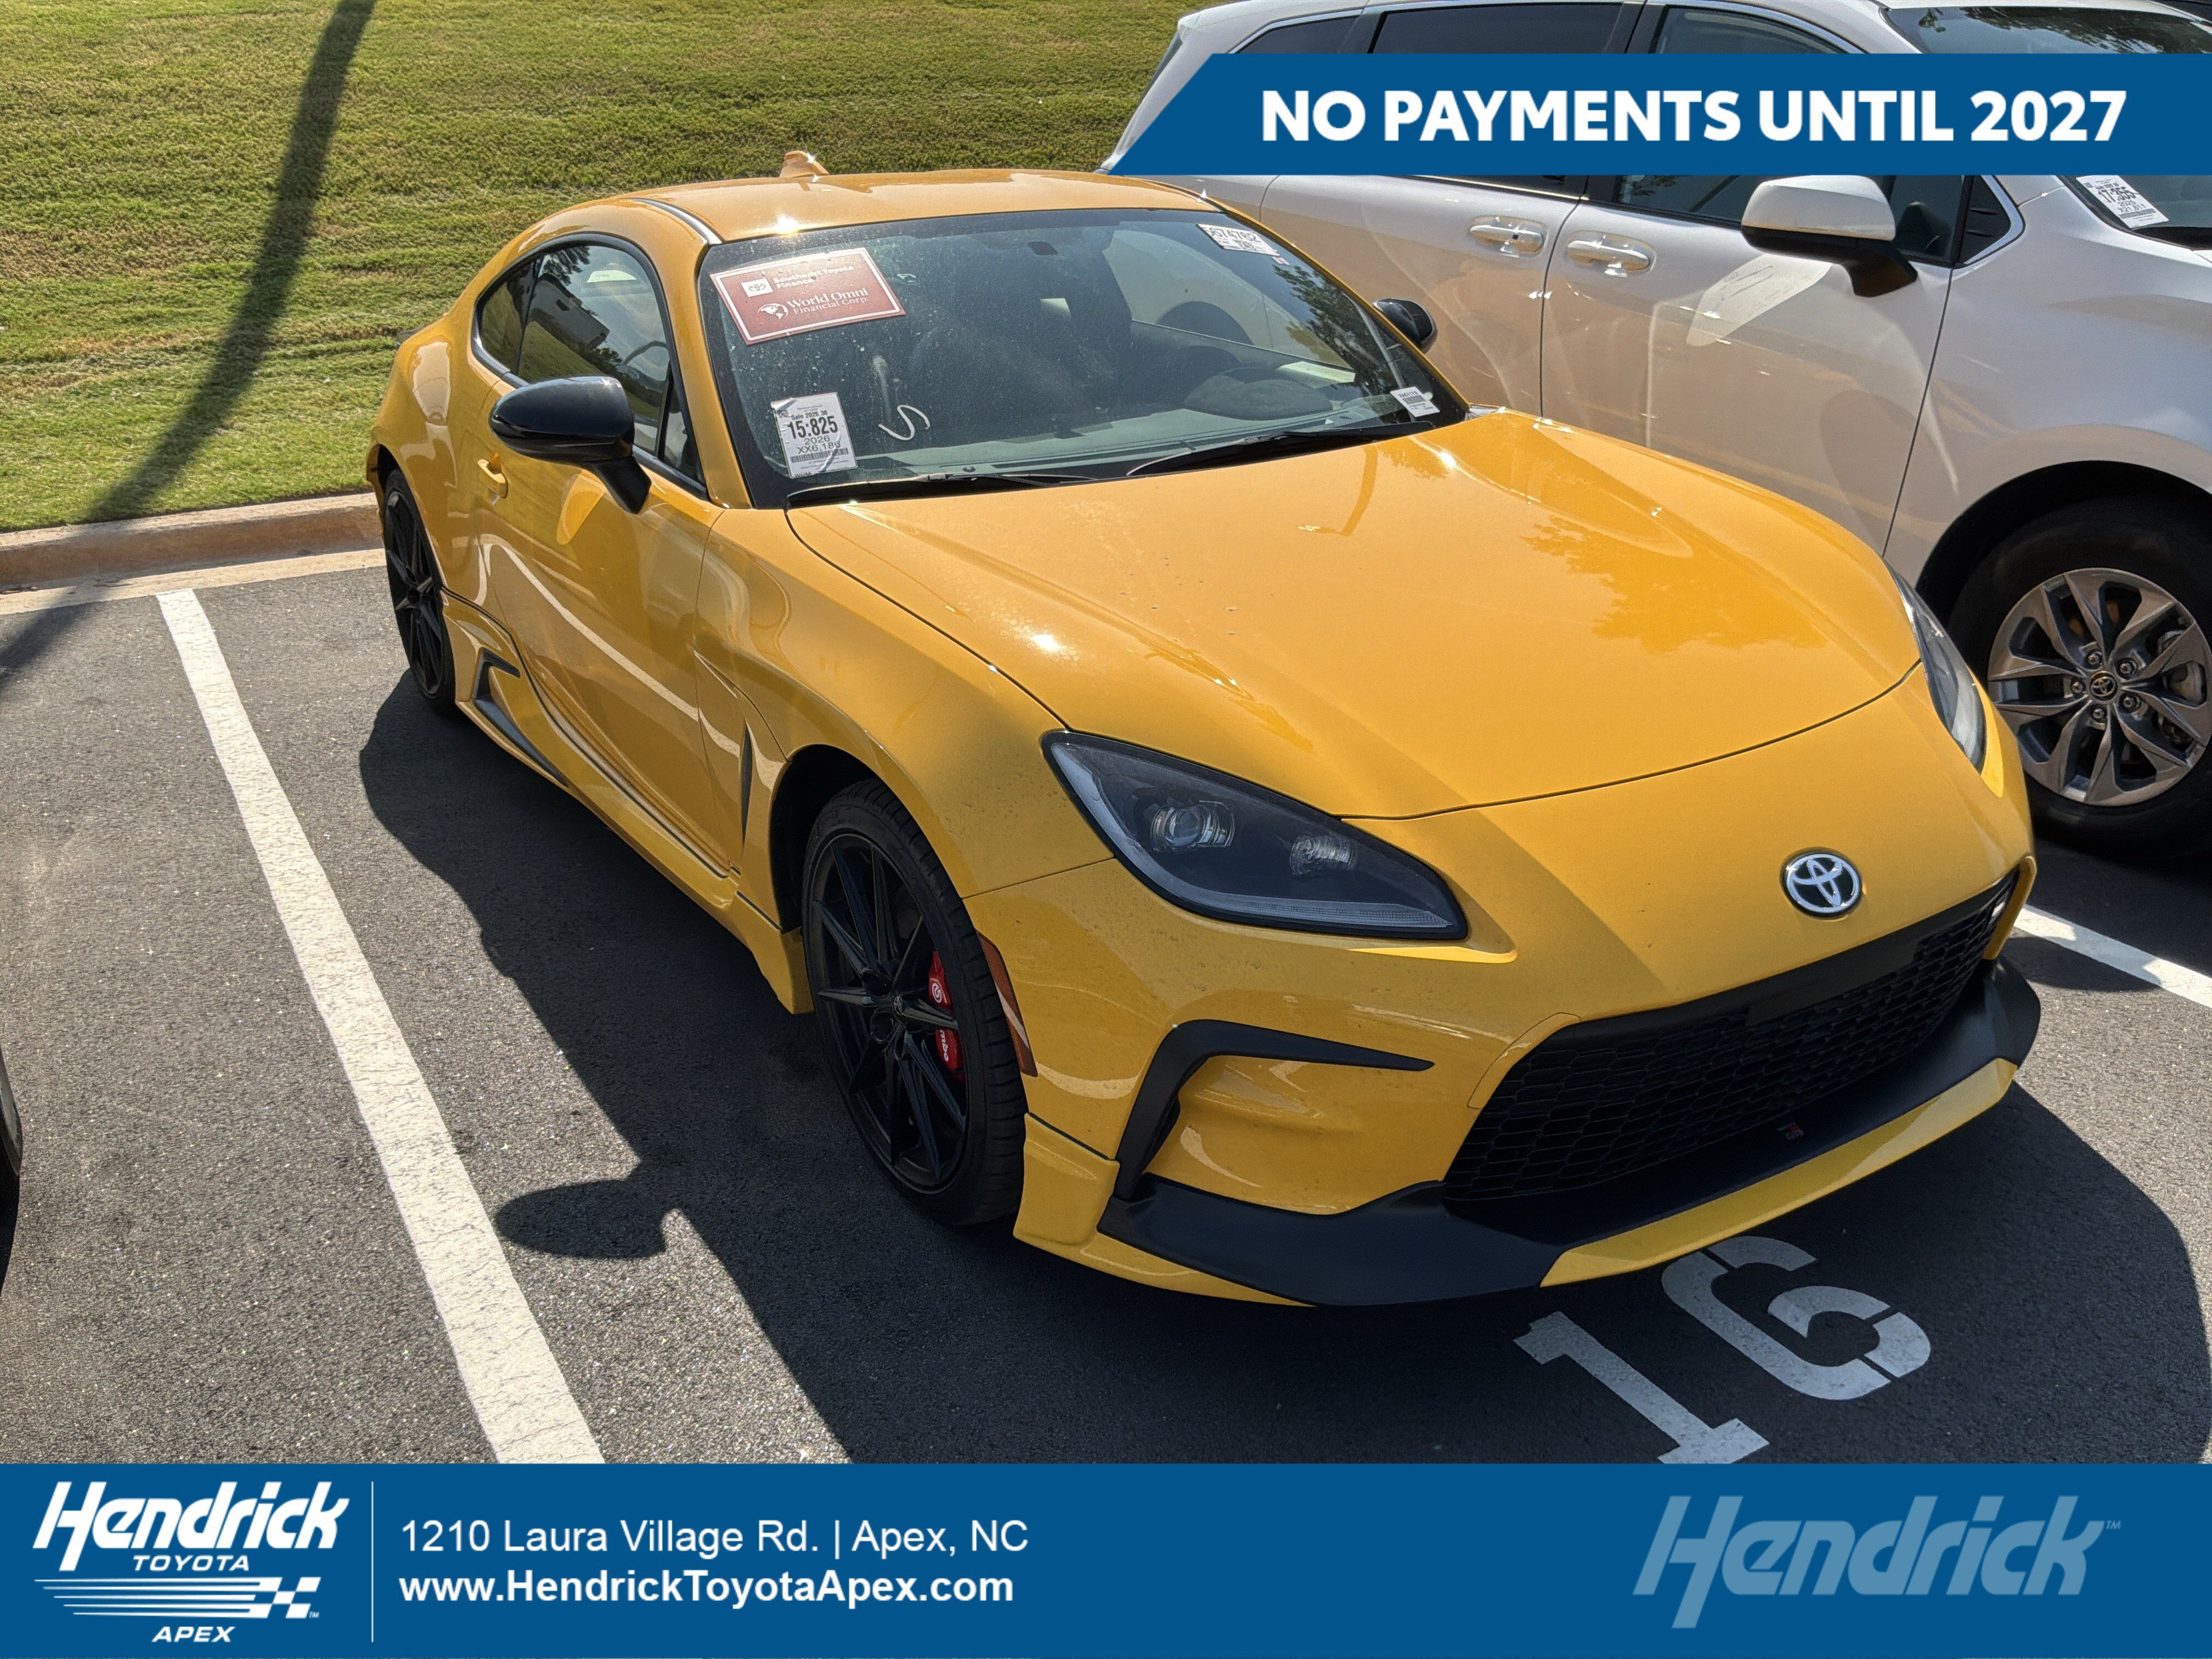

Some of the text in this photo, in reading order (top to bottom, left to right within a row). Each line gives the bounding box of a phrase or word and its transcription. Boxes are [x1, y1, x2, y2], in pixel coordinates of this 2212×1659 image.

[825, 266, 854, 275] Toyota
[776, 279, 814, 289] Finance
[787, 287, 869, 308] World Omni
[793, 297, 869, 314] Financial Corp.
[787, 415, 838, 439] 15:825
[804, 435, 831, 445] 2026
